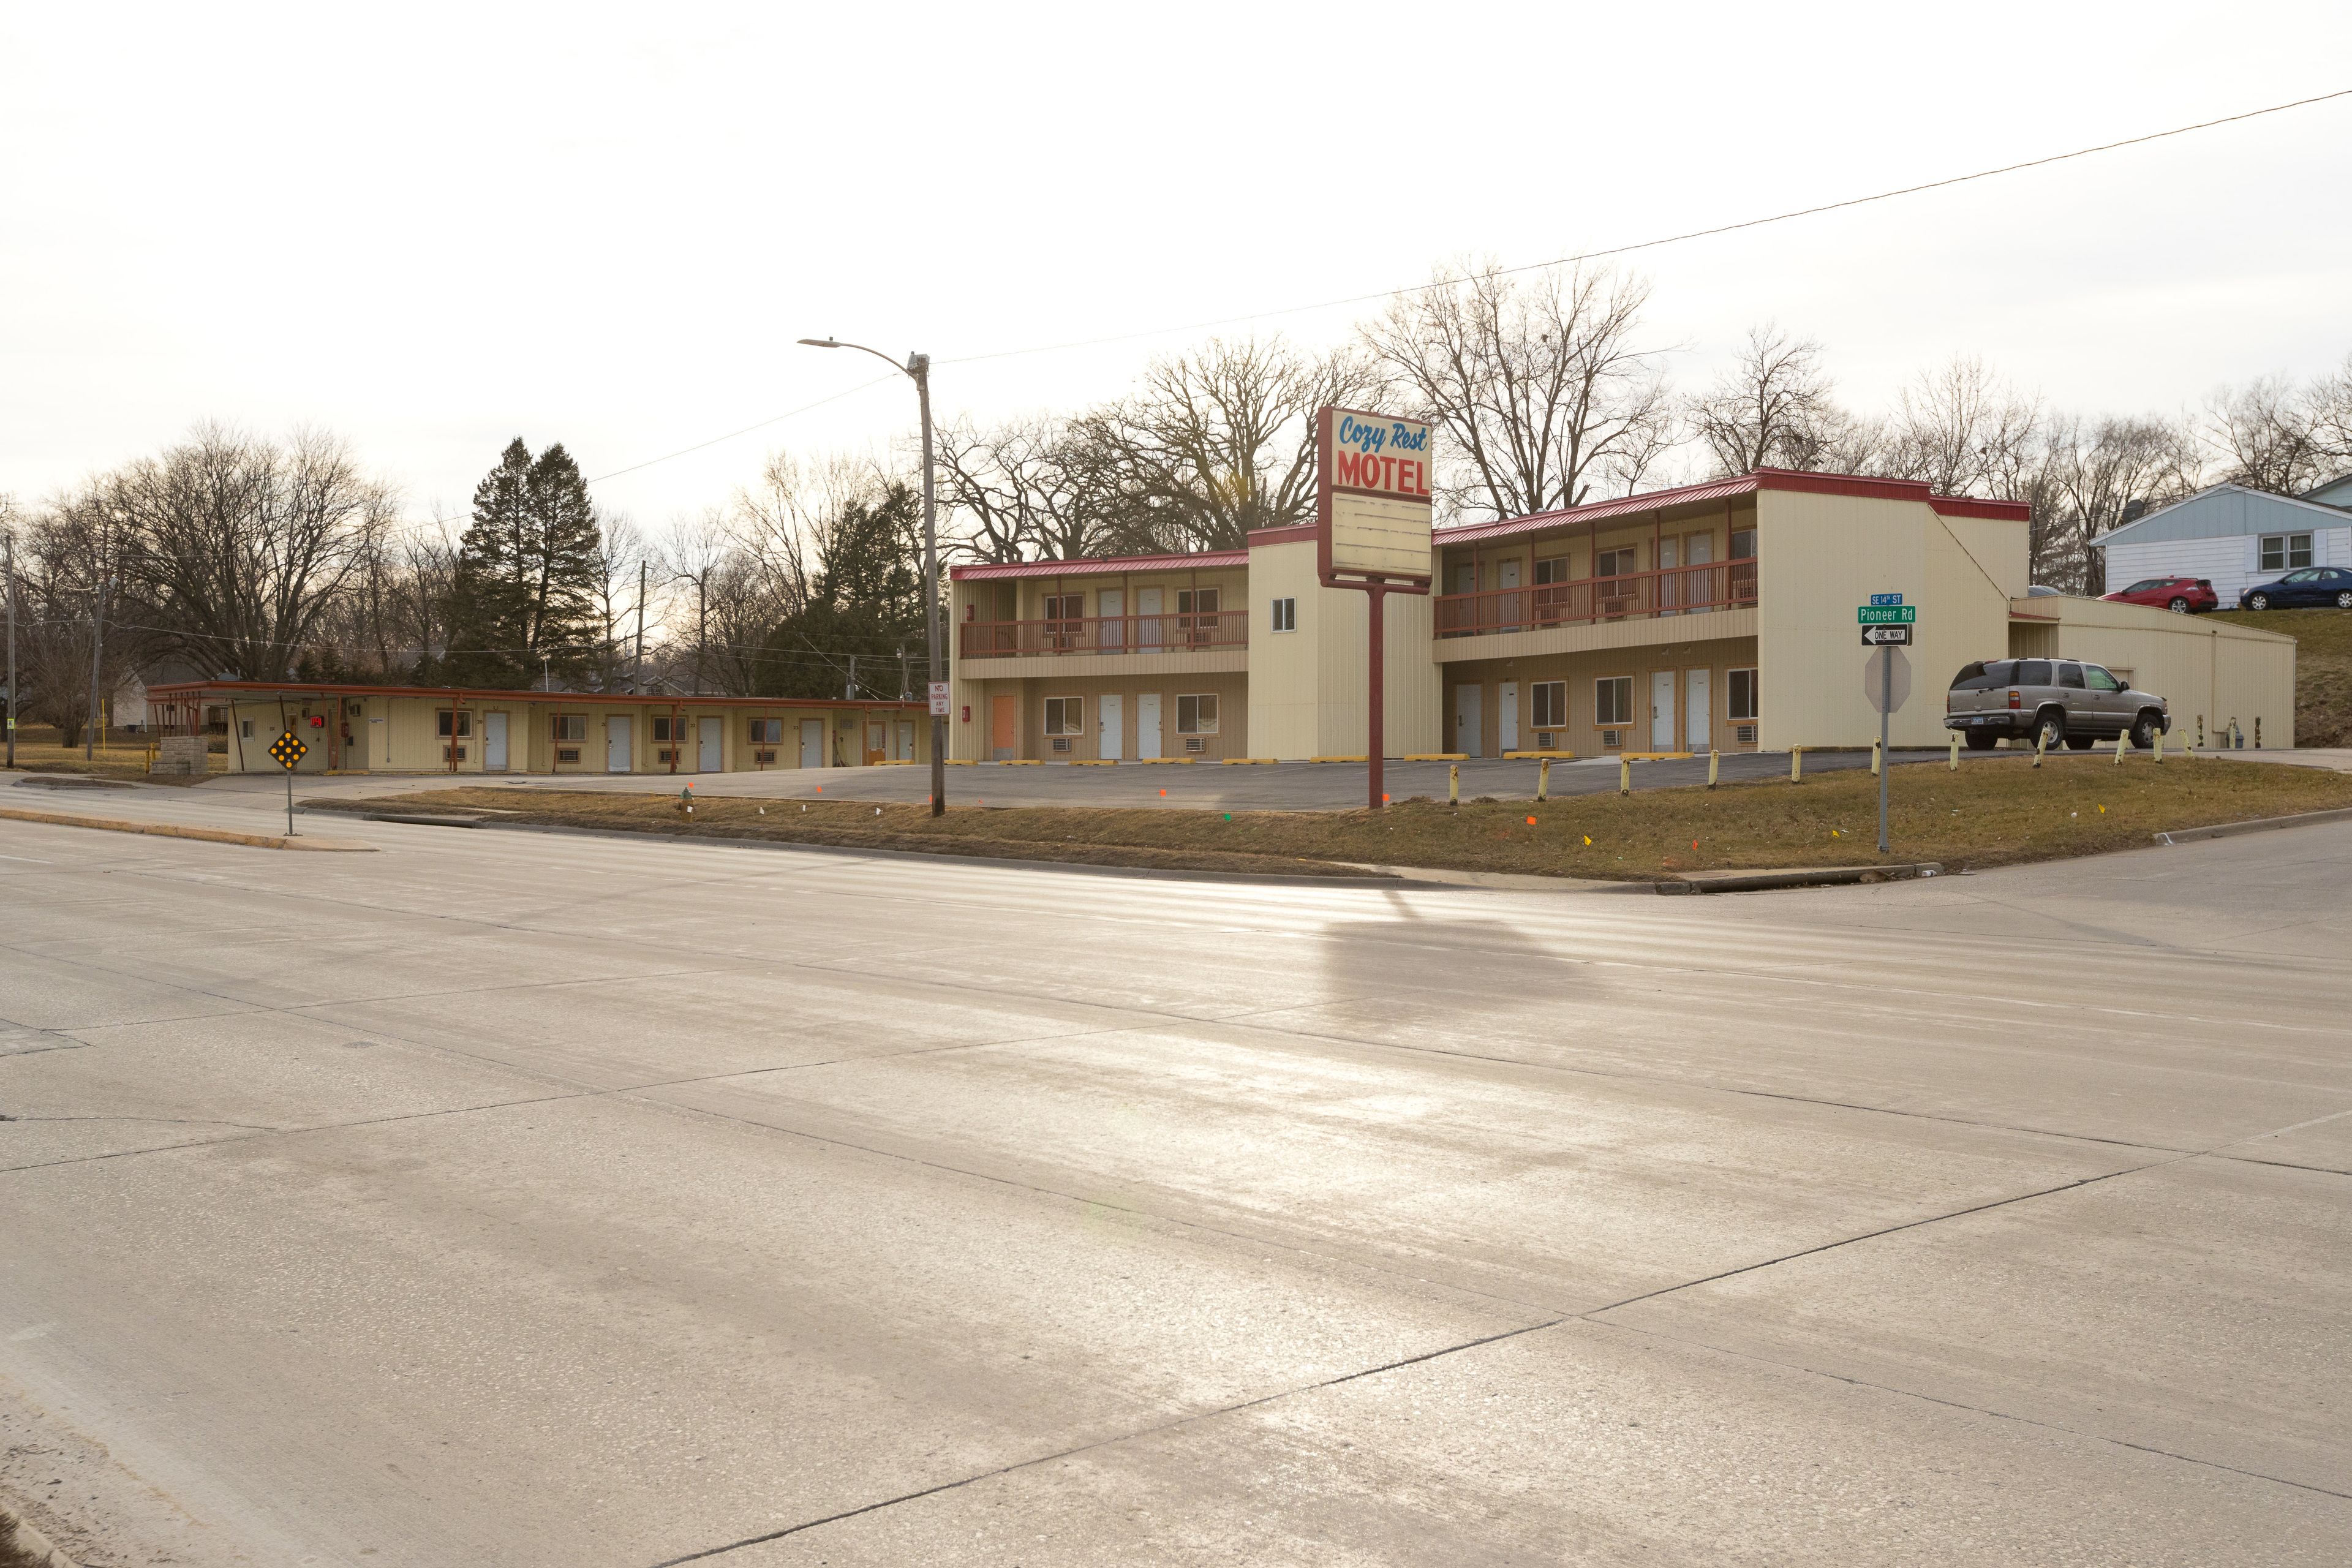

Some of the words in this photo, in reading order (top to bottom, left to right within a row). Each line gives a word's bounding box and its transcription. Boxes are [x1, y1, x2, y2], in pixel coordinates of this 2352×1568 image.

[1339, 416, 1386, 453] Cozy
[1390, 423, 1428, 451] Rest
[1338, 450, 1429, 496] MOTEL
[1872, 596, 1879, 605] SE
[1880, 595, 1891, 604] 14TH
[1892, 595, 1901, 604] ST
[1861, 609, 1896, 621] Pioneer
[1902, 608, 1913, 620] Rd
[1874, 631, 1887, 639] ONE
[1890, 631, 1903, 639] WAY
